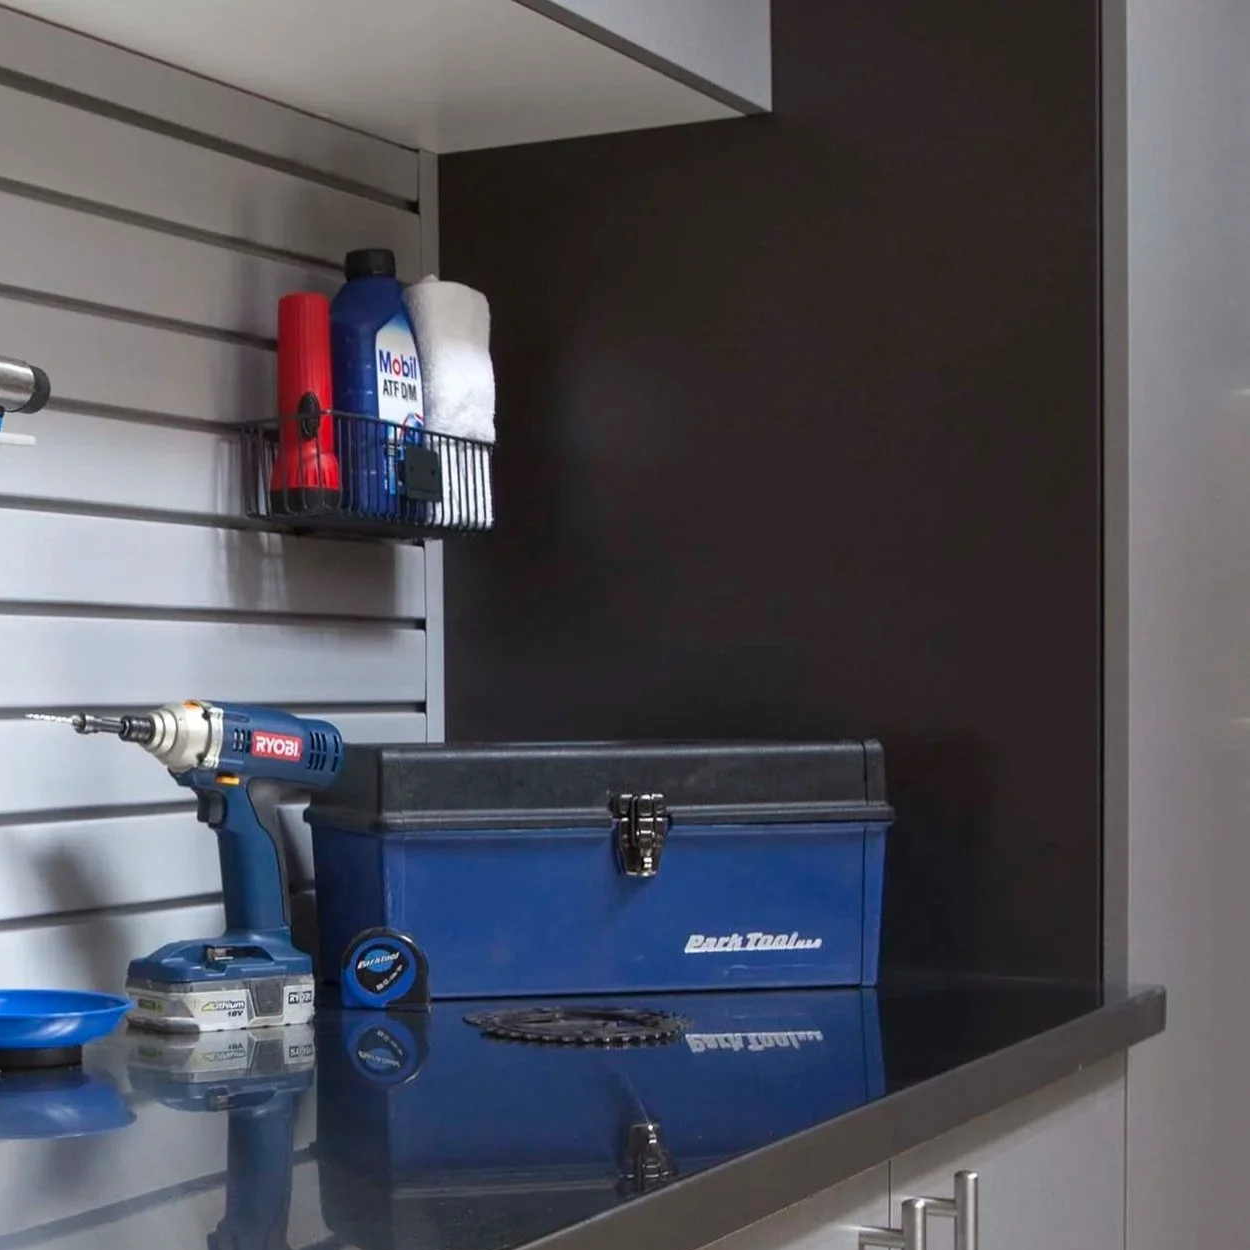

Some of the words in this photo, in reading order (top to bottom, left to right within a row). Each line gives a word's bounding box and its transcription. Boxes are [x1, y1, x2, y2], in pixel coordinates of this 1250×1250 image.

[379, 350, 418, 379] Mobil
[382, 379, 400, 398] ATF
[255, 735, 299, 757] RYOBI
[684, 933, 743, 954] Park
[743, 931, 798, 951] Tool
[227, 1009, 244, 1018] 18V
